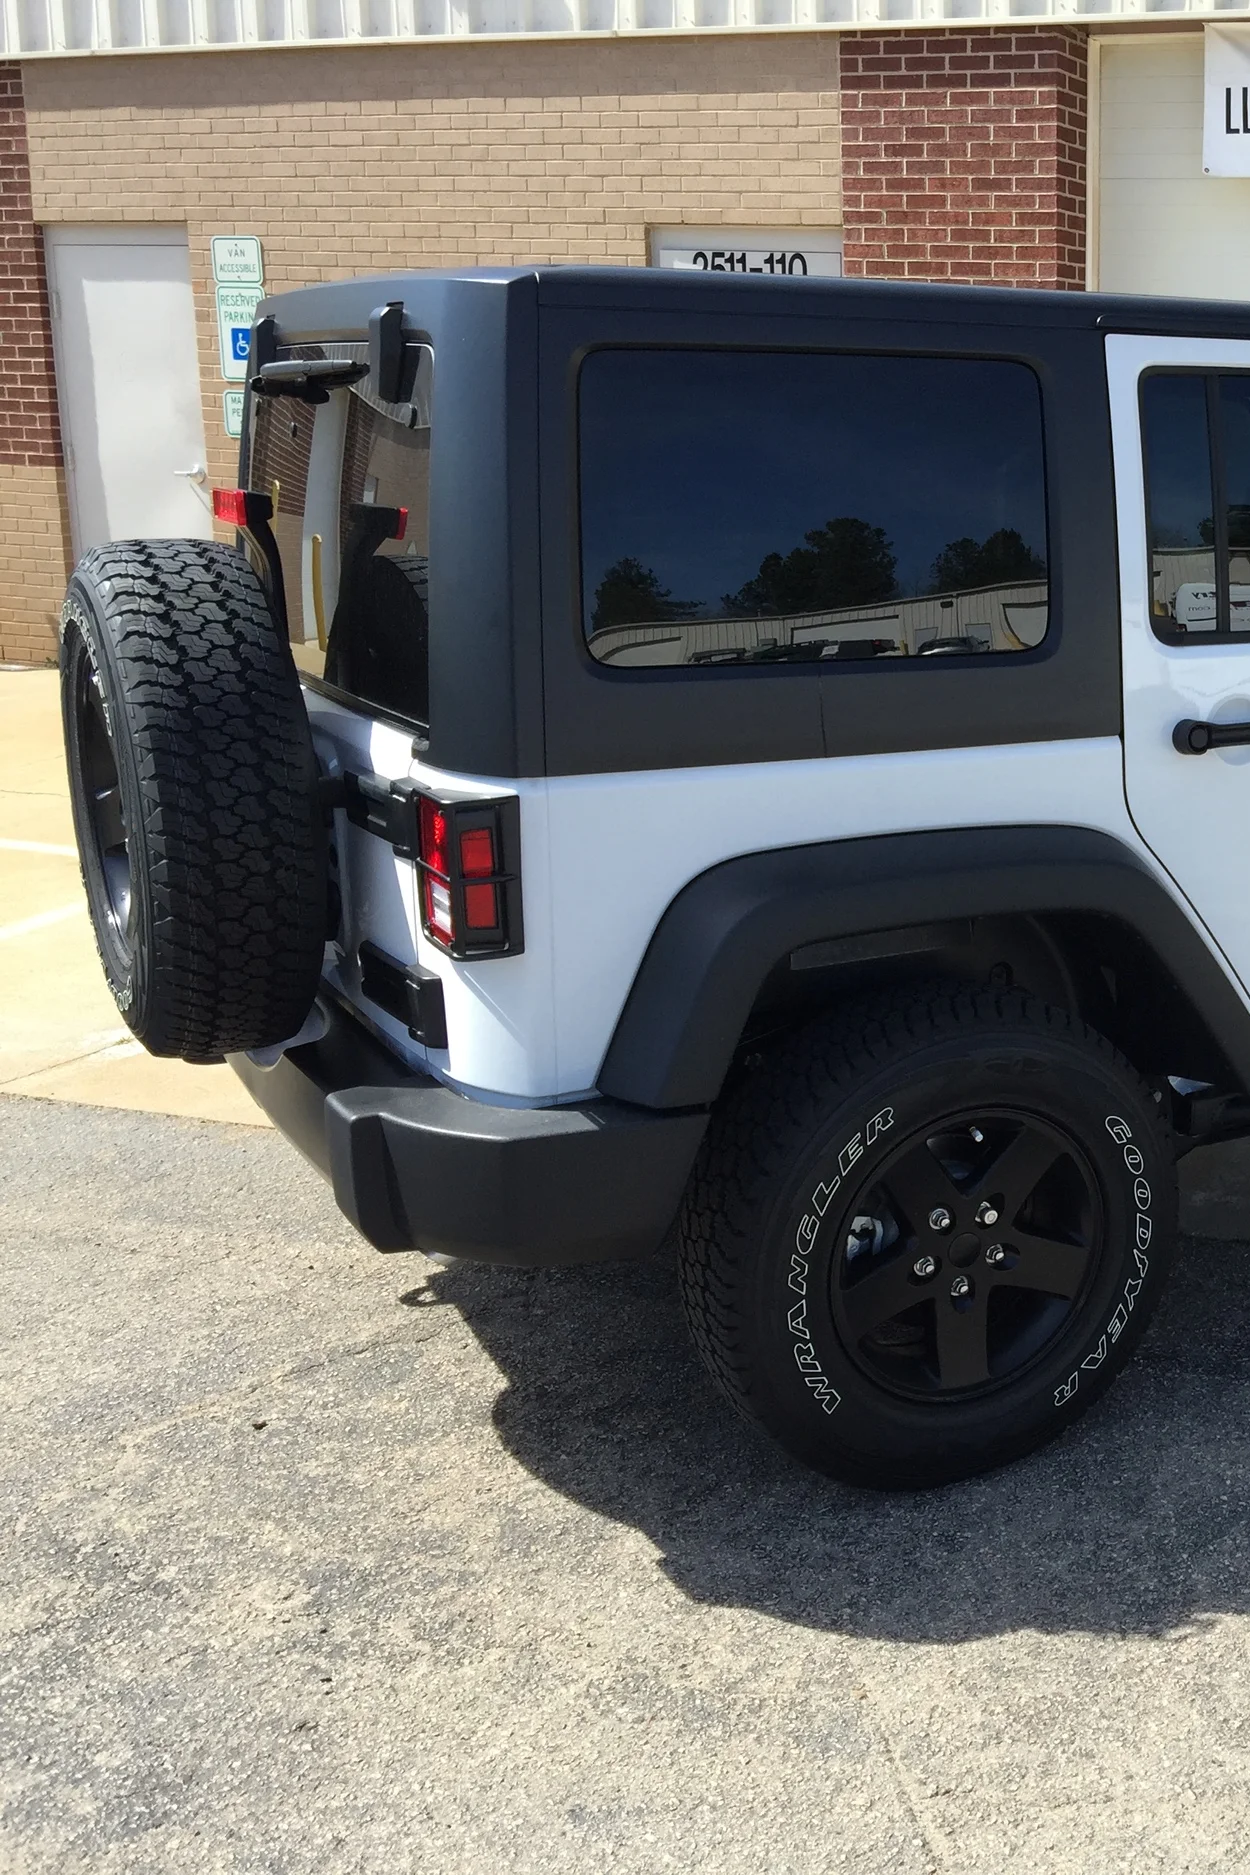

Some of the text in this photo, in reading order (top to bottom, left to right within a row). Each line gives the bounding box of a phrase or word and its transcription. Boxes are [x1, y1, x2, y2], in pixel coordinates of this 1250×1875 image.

[227, 248, 246, 258] VAN
[219, 263, 257, 273] ACCESSIBLE
[223, 311, 254, 324] PARKIN
[786, 1106, 895, 1415] WRANGLER
[1053, 1115, 1154, 1407] GOODYEAR
